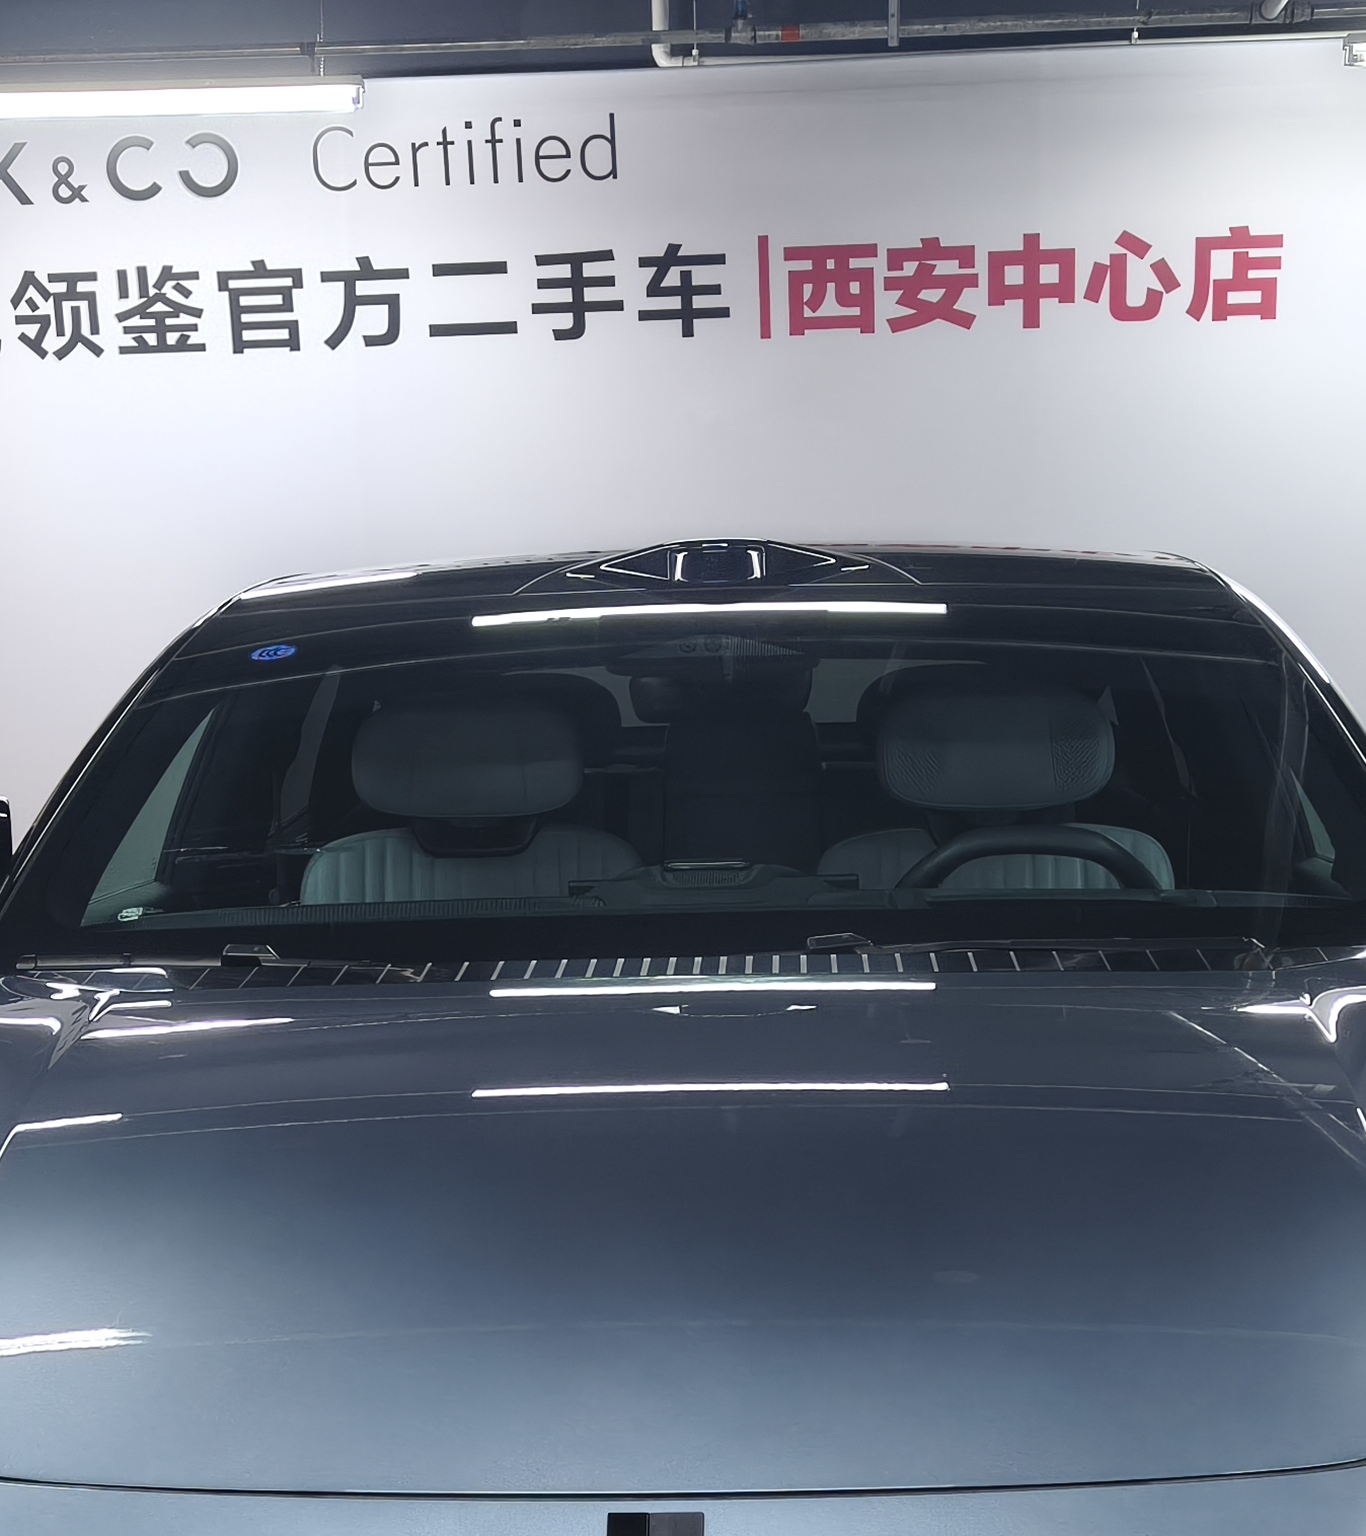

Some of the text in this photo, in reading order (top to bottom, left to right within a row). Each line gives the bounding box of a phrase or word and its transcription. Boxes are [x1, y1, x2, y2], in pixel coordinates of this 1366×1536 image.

[312, 112, 619, 192] Certified
[782, 226, 1284, 336] 西安中心店
